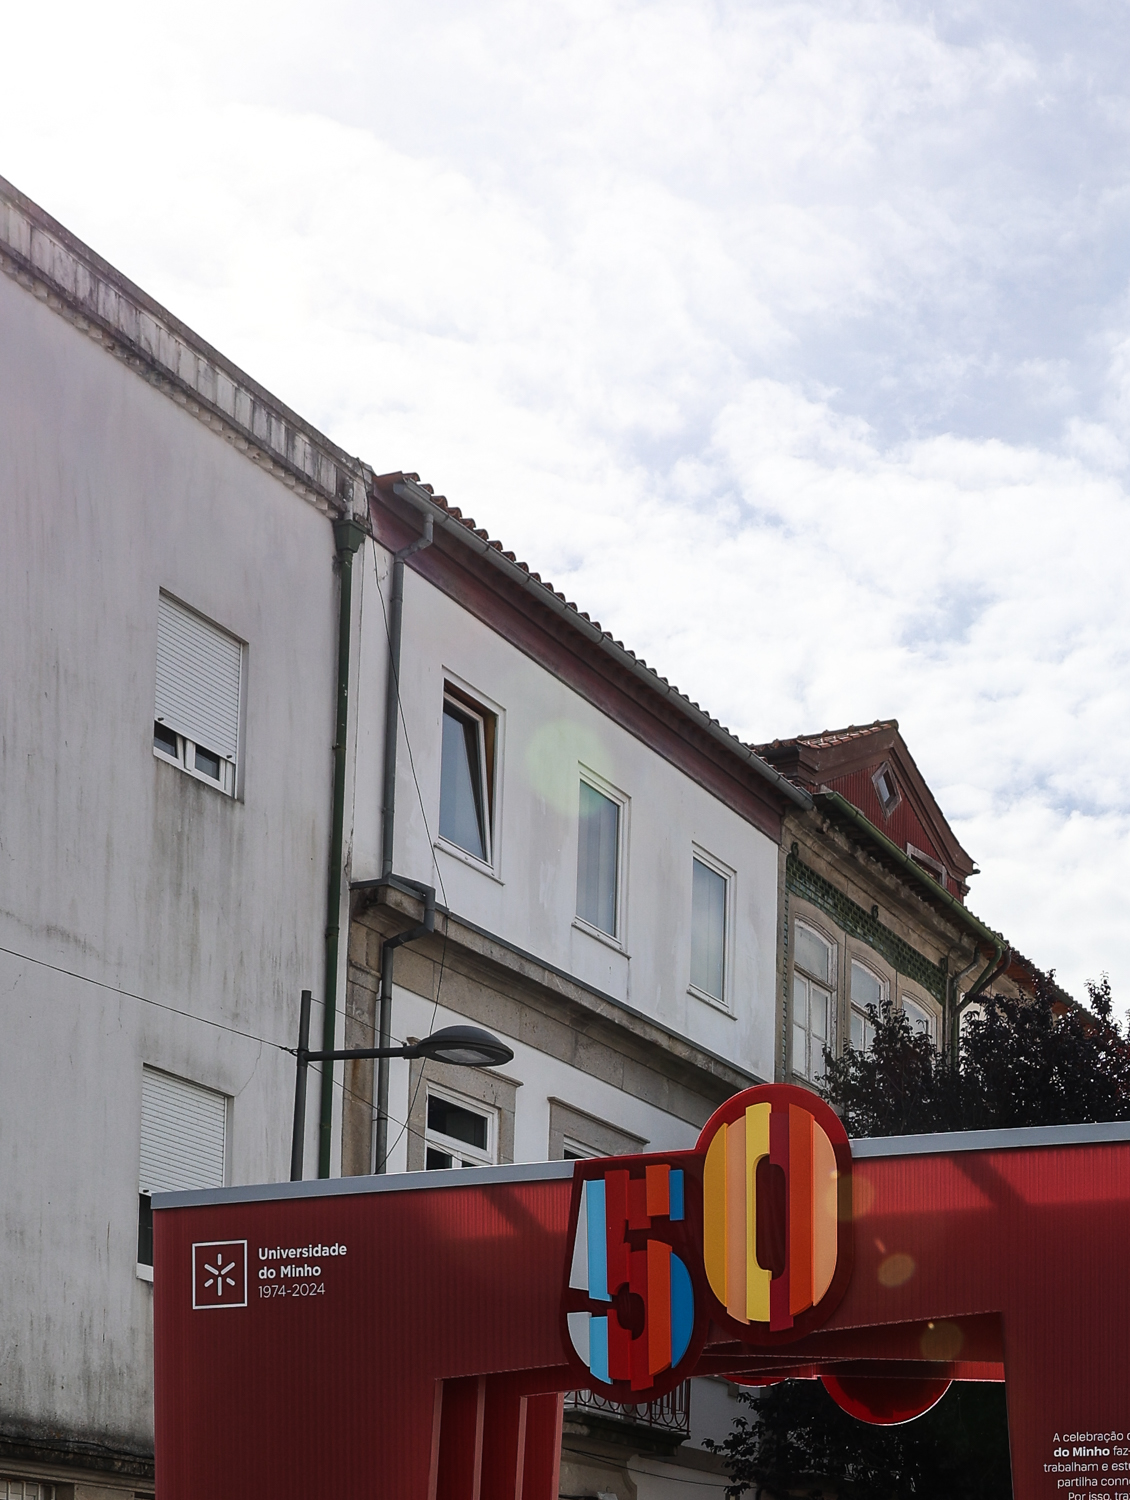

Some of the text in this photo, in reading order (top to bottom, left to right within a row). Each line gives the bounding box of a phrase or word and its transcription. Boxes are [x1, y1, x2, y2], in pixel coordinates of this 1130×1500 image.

[258, 1243, 348, 1260] Universidade
[567, 1102, 838, 1391] 50
[258, 1264, 322, 1279] do Minho
[258, 1282, 326, 1299] 1974-2024
[1052, 1432, 1061, 1442] A
[1062, 1431, 1124, 1443] celebração
[1053, 1447, 1070, 1458] do
[1072, 1446, 1111, 1457] Minho
[1043, 1461, 1099, 1473] trabalham
[1101, 1463, 1109, 1472] e
[1057, 1476, 1098, 1489] partilha
